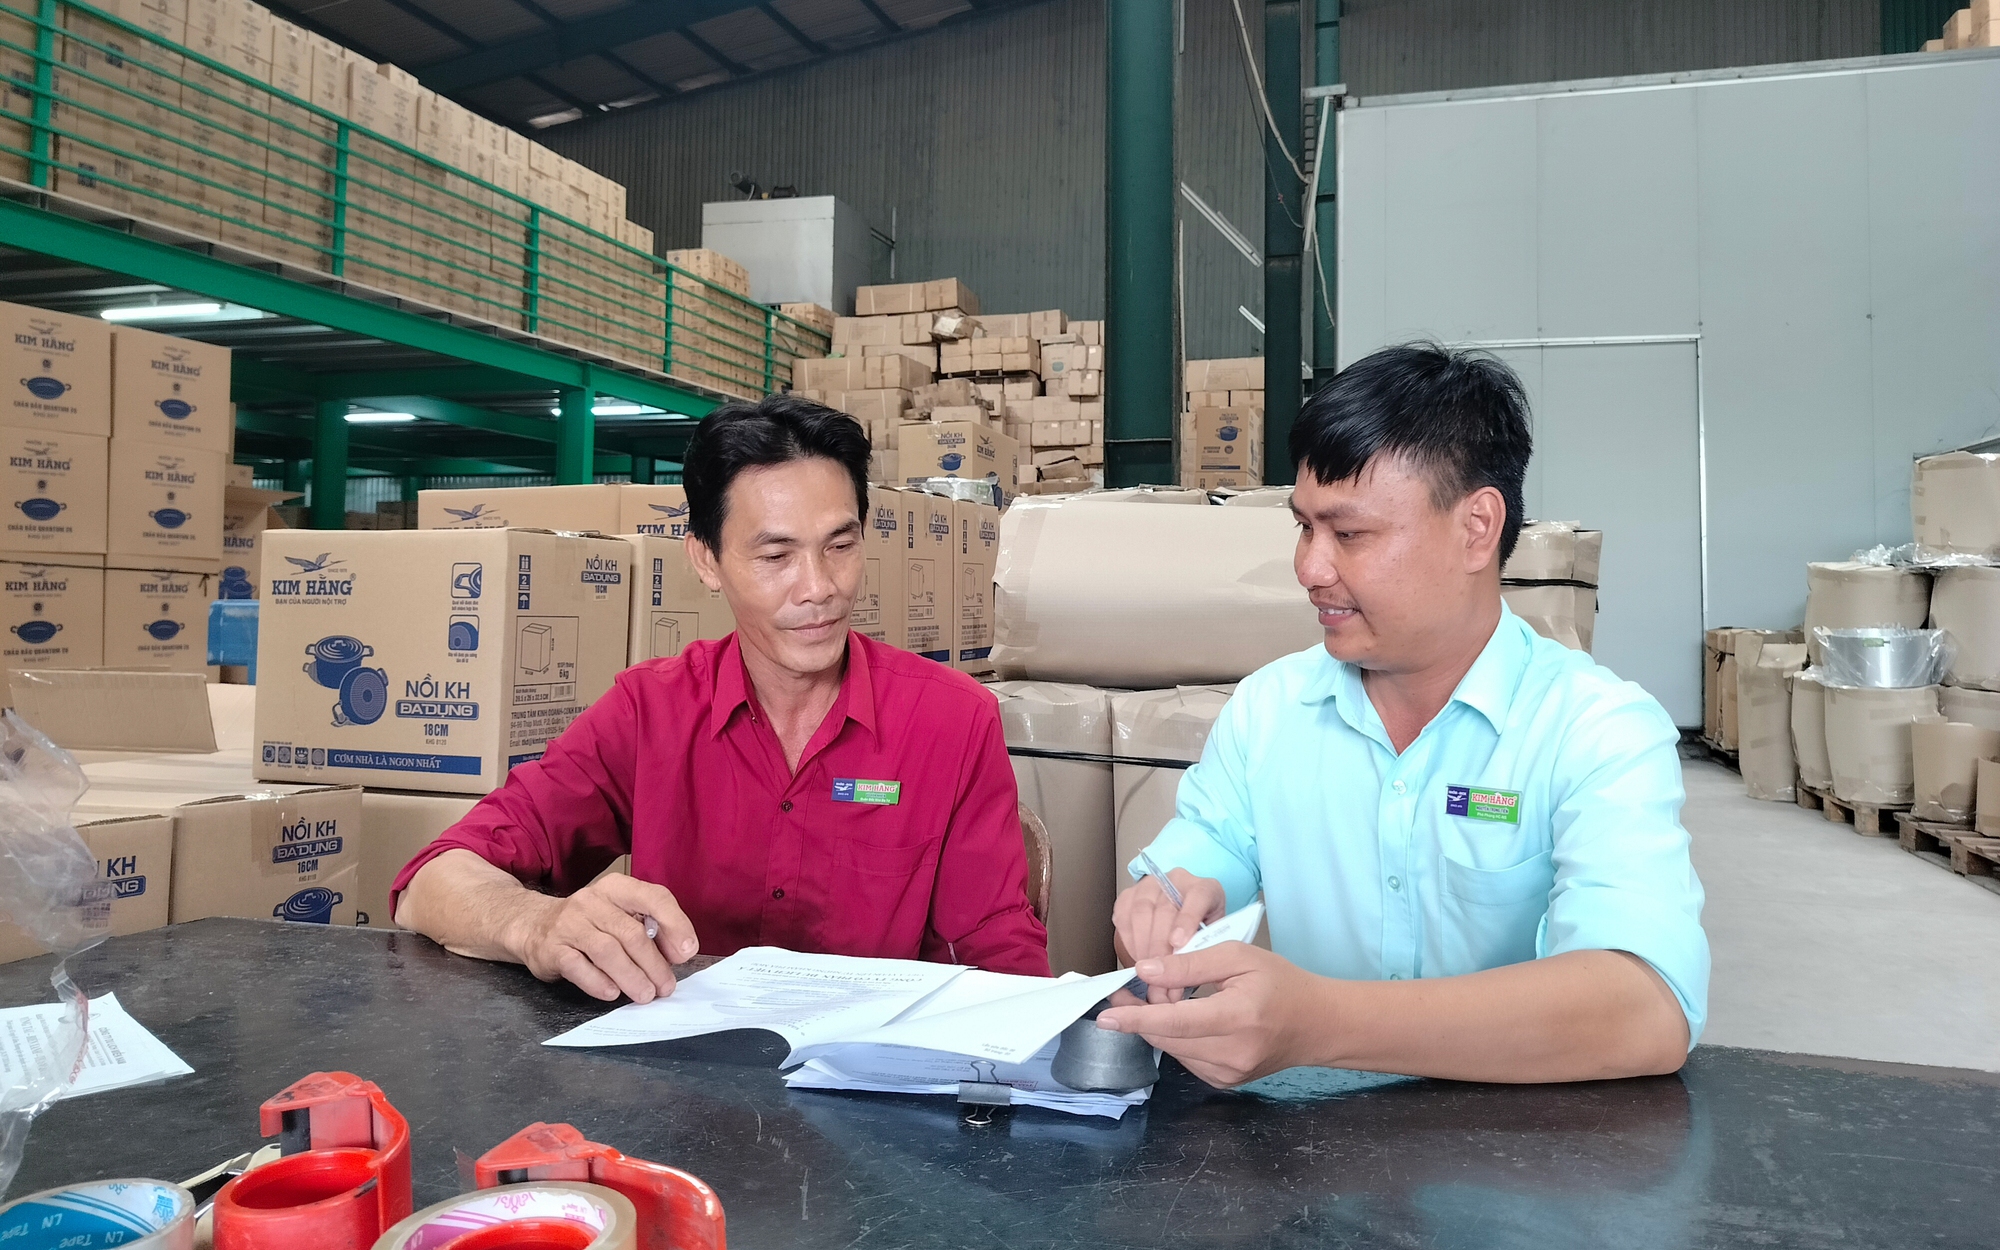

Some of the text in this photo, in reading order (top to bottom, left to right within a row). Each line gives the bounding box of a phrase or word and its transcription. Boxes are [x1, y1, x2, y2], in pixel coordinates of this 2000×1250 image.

[15, 333, 37, 346] KIM
[151, 360, 169, 371] KIM
[10, 456, 32, 467] KIM
[145, 470, 164, 480] KIM
[636, 524, 666, 534] KIM
[604, 559, 618, 571] KH
[272, 574, 352, 596] KIM HẰNG
[521, 575, 528, 585] 2
[654, 576, 660, 584] 2
[5, 581, 28, 592] KIM
[140, 583, 158, 593] KIM
[288, 597, 302, 605] CỦA
[406, 673, 470, 699] NỒI KH
[424, 723, 449, 737] 18CM
[334, 752, 442, 768] CƠM NHÀ LÀ NGON NHẤT
[1472, 793, 1488, 803] KIM
[282, 816, 336, 843] NỒI KH
[106, 855, 136, 878] KH
[297, 858, 319, 874] 16CM
[1, 1213, 63, 1241] LN Tape
[58, 1231, 124, 1249] LN Tape
